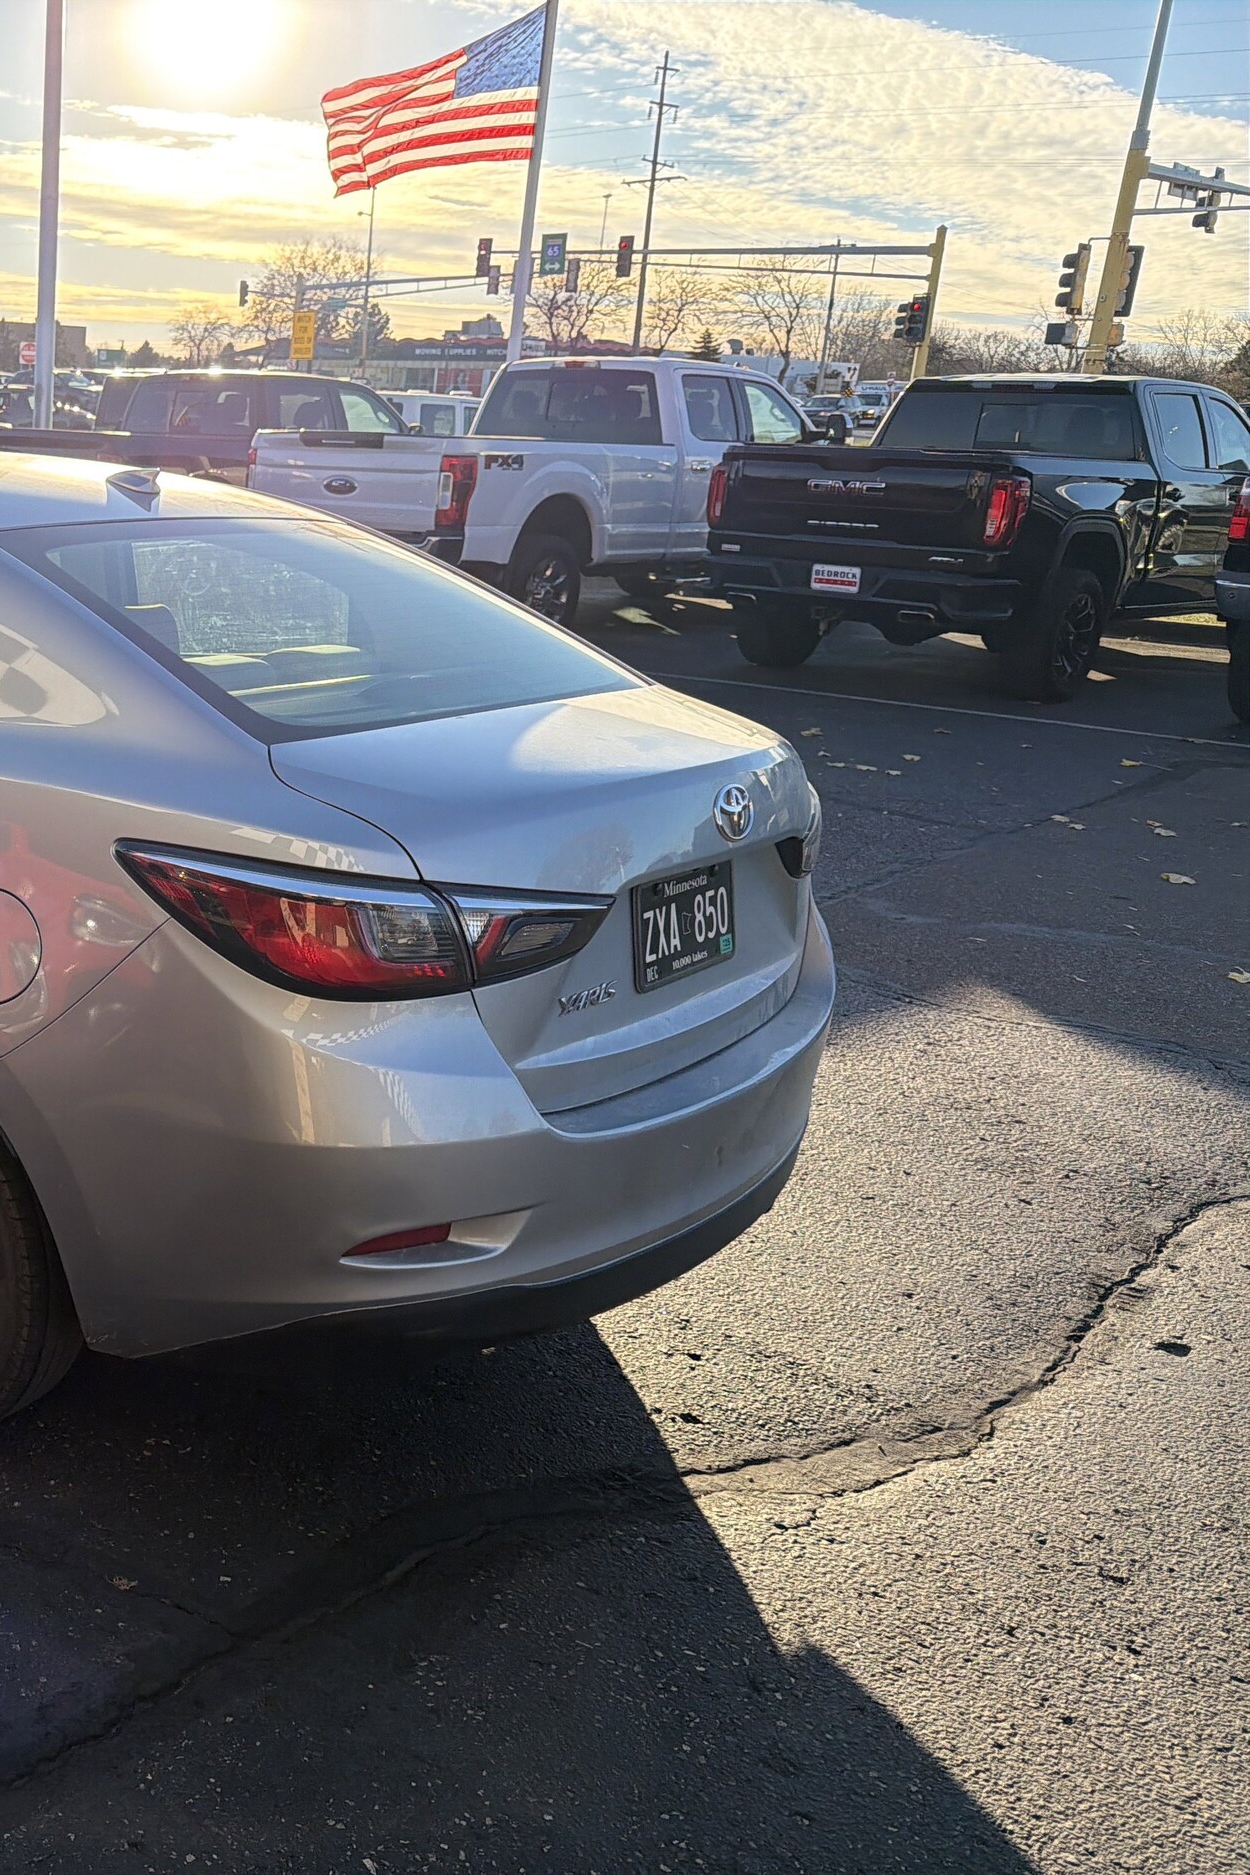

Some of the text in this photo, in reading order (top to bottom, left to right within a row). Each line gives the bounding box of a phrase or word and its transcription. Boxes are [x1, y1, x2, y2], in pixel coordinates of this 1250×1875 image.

[547, 246, 560, 257] 65
[414, 348, 442, 356] MOVING
[484, 454, 524, 470] FX4
[807, 479, 886, 497] GMC
[814, 569, 858, 580] BEDROCK
[663, 874, 708, 898] Minnesota
[643, 886, 729, 964] ZXA 850
[672, 950, 708, 970] 10,000 lakes
[646, 965, 659, 983] DEC
